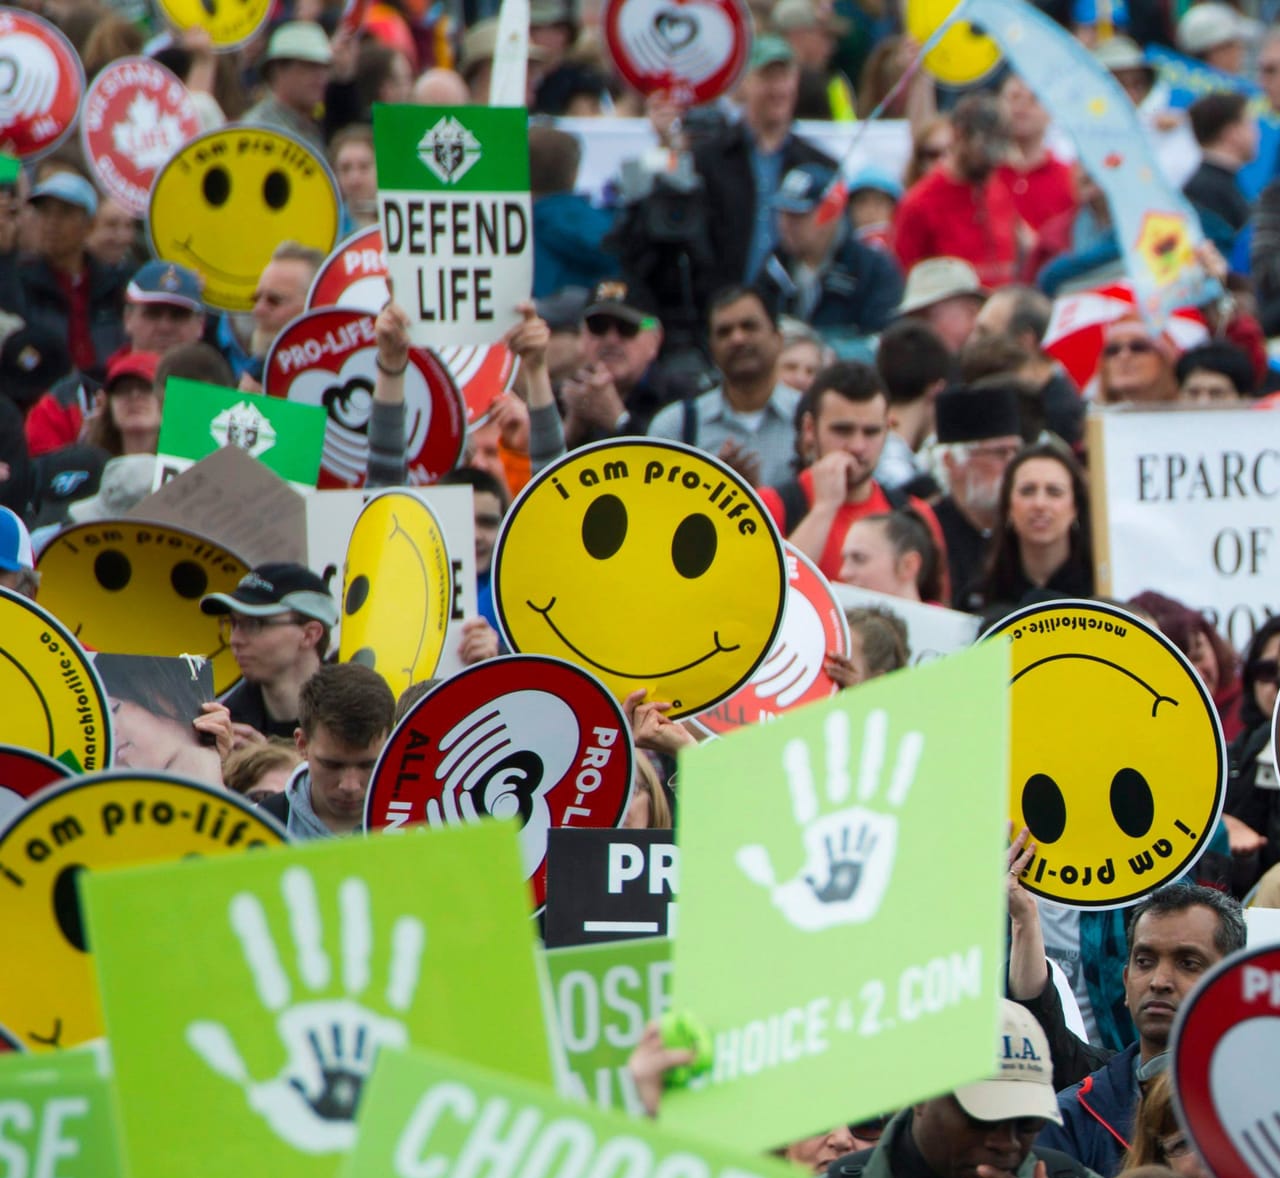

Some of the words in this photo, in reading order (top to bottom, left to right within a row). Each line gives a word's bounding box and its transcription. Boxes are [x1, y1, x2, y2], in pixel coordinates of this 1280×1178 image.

[236, 139, 315, 179] pro-life
[384, 201, 527, 256] DEFEND
[418, 268, 494, 322] LIFE
[550, 476, 571, 501] i
[578, 459, 629, 489] am
[643, 459, 757, 537] pro-life
[83, 529, 124, 547] am
[136, 530, 239, 576] pro-life
[1212, 526, 1274, 578] OF
[560, 726, 619, 829] PRO-L
[25, 814, 86, 865] am
[1173, 819, 1197, 841] i
[1127, 838, 1174, 876] am
